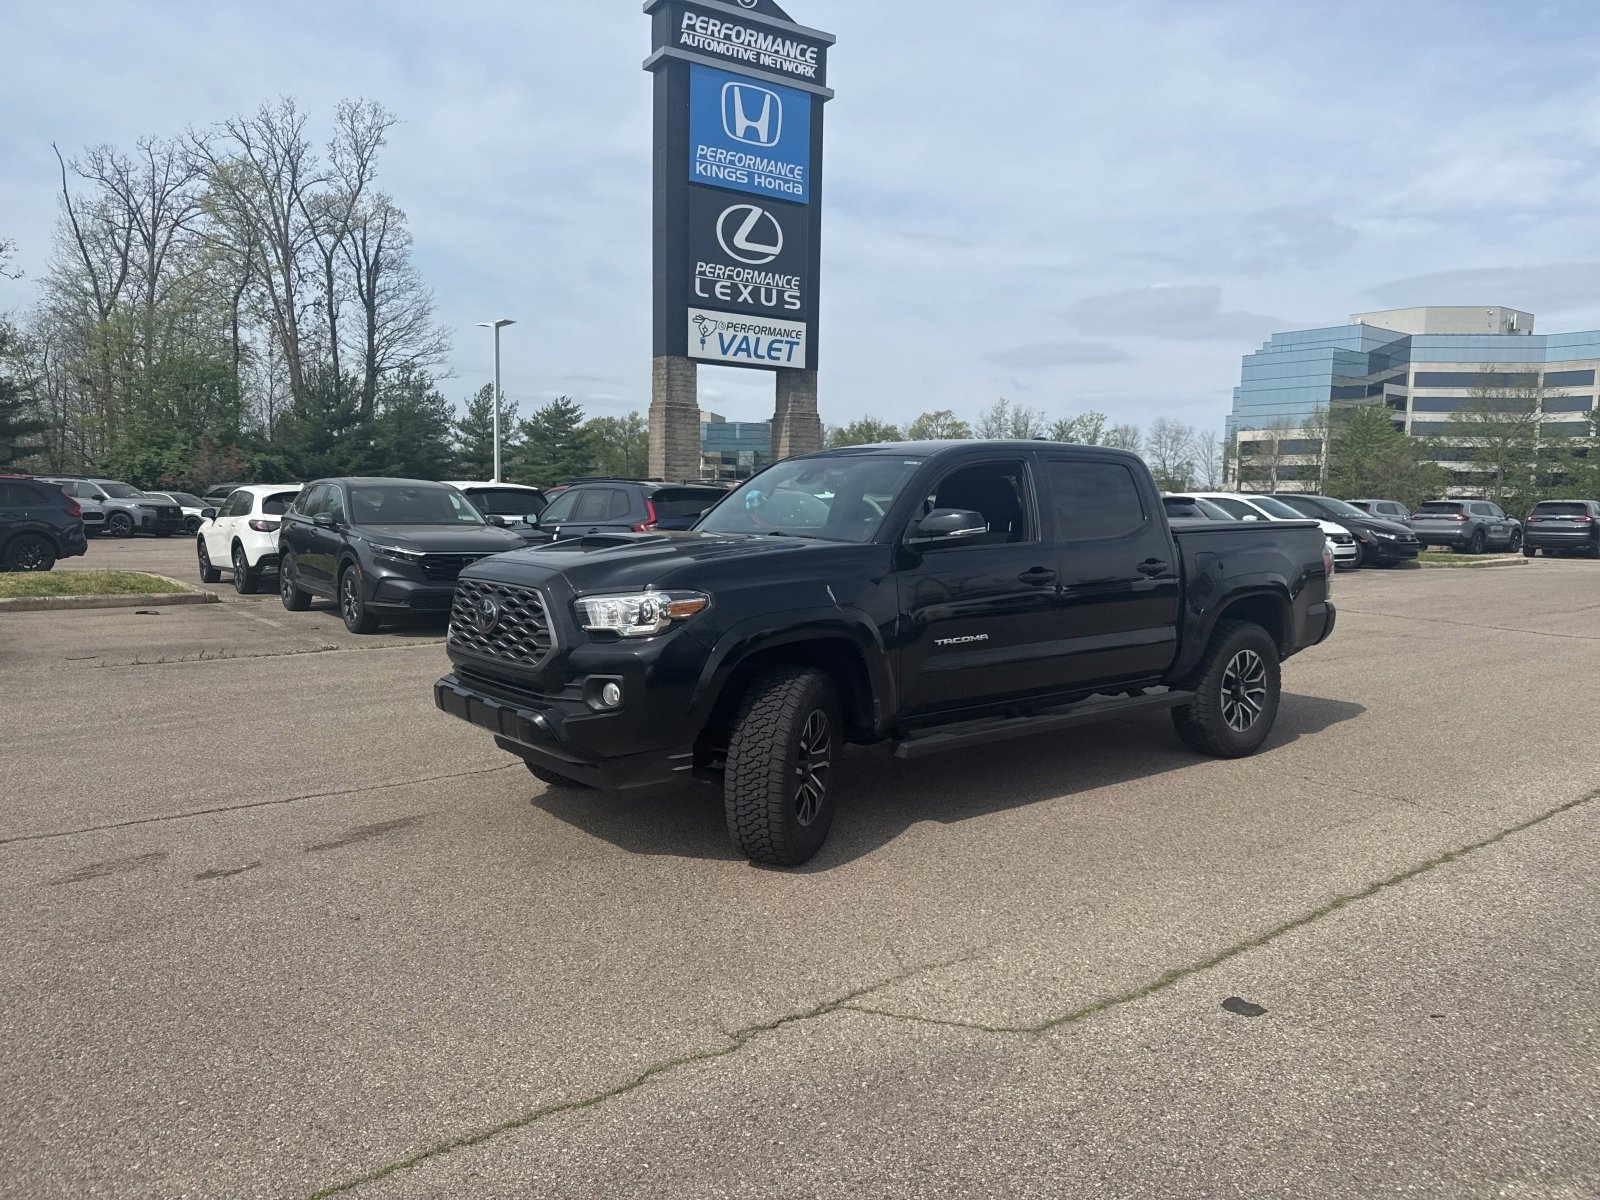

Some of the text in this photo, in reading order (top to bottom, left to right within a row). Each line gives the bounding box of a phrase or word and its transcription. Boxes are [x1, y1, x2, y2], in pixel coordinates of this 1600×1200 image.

[681, 11, 818, 64] PERFORMANCE
[680, 33, 816, 79] AUTOMOTIVE NETWORK
[696, 144, 803, 179] PERFORMANCE
[695, 162, 803, 195] KINGS Honda
[695, 261, 801, 289] PERFORMANCE
[694, 277, 801, 310] LEXUS
[718, 332, 800, 362] VALET
[725, 321, 802, 340] PERFORMANCE
[934, 633, 989, 646] TACOMA
